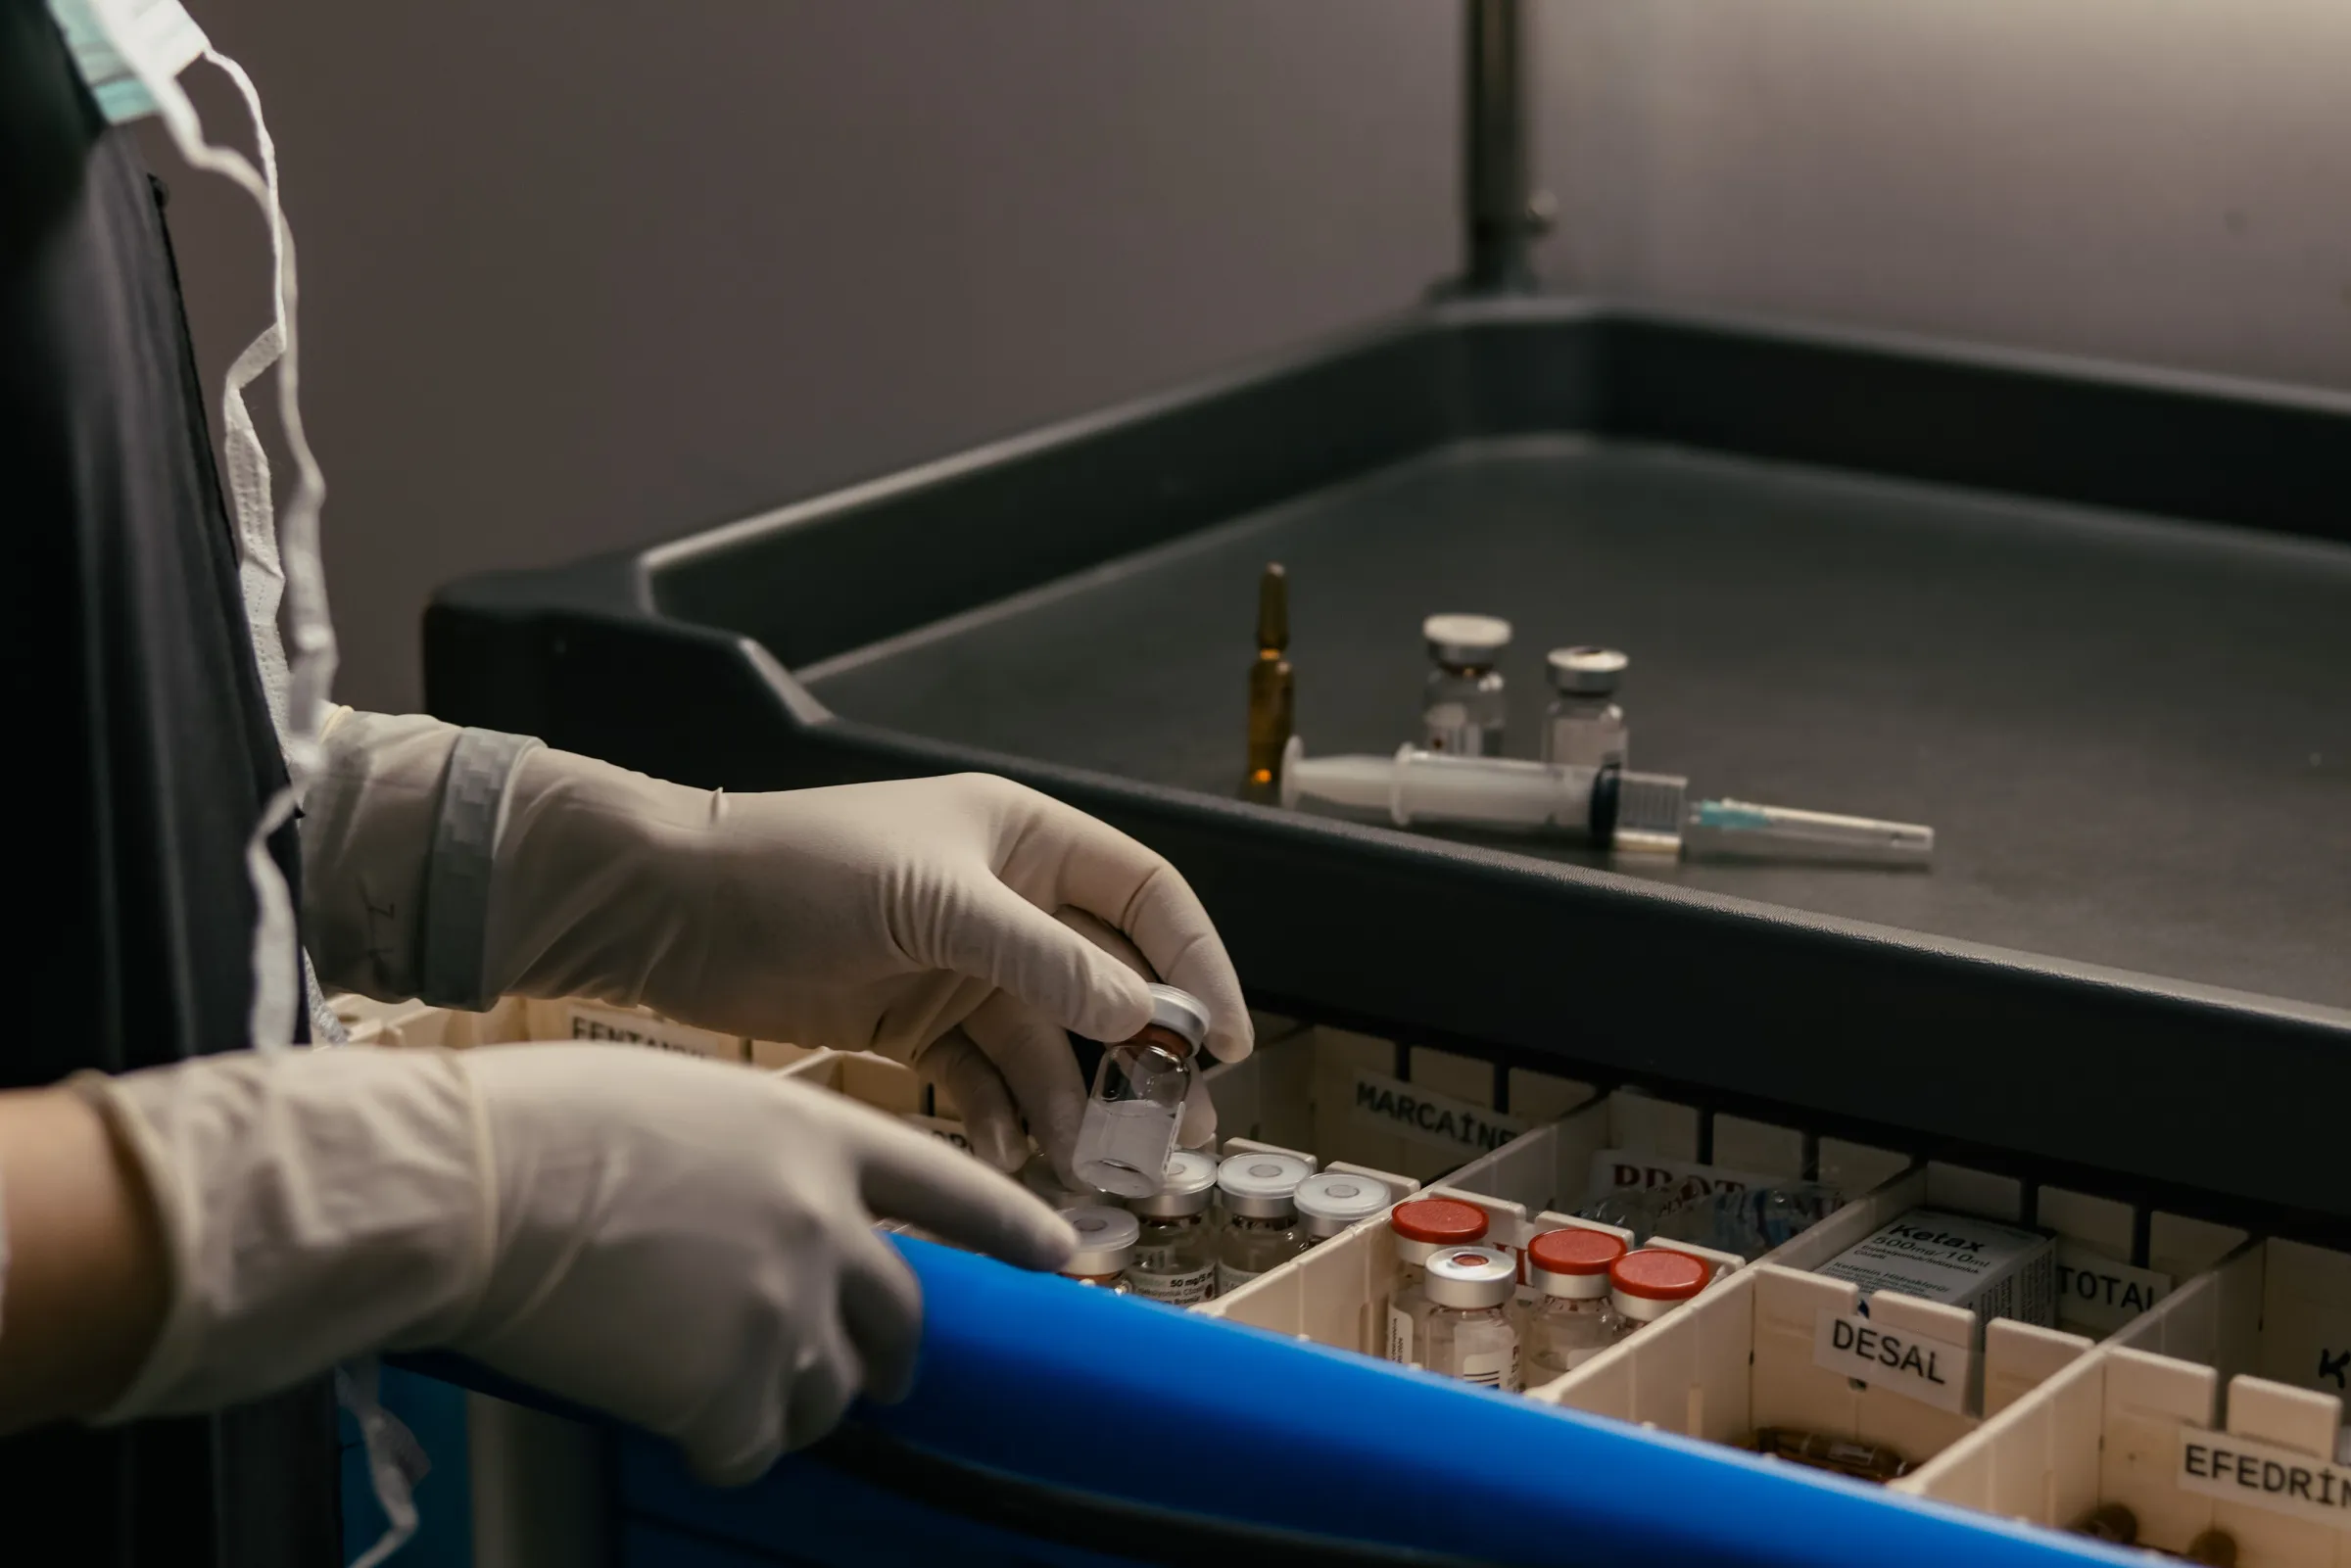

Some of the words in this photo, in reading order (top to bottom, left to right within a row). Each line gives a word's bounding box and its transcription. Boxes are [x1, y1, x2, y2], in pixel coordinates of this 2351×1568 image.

[1889, 1224, 1985, 1253] Ketax
[1170, 1279, 1183, 1288] 50
[1833, 1319, 1944, 1384] DESAL
